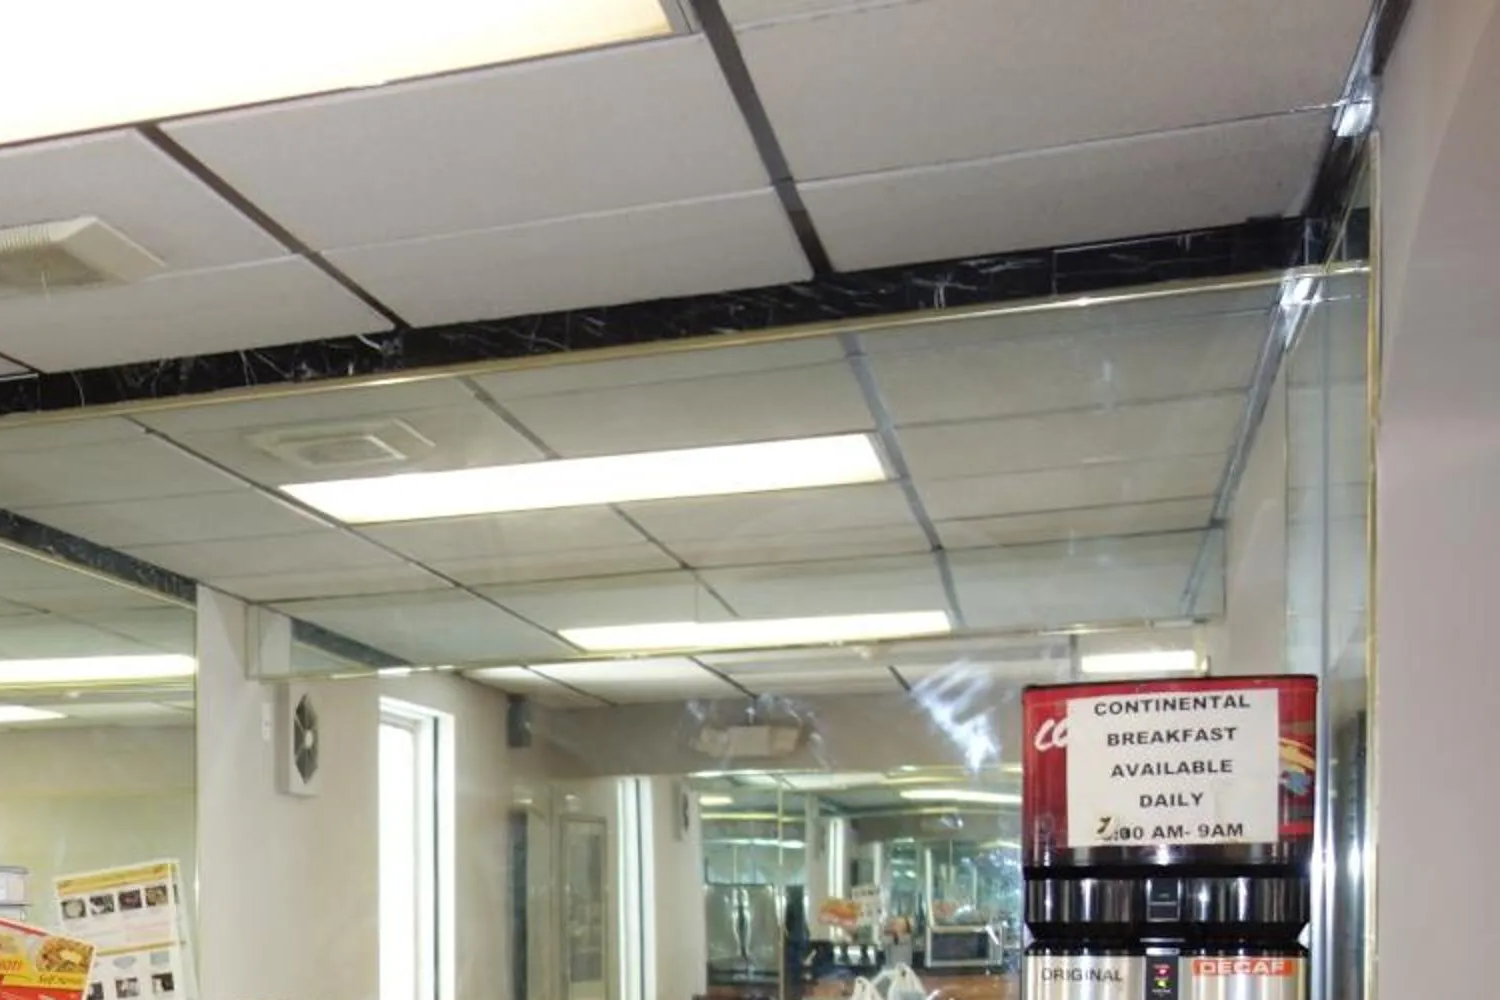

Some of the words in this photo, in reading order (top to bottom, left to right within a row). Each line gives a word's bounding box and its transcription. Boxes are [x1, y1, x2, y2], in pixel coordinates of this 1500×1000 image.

[1094, 694, 1250, 716] CONTINENTAL
[1107, 727, 1237, 747] BREAKFAST
[1111, 759, 1233, 778] AVAILABLE
[1139, 792, 1204, 808] DAILY
[1198, 823, 1244, 839] 9AM
[1041, 966, 1124, 982] ORIGINAL
[1199, 960, 1286, 975] DECAF
